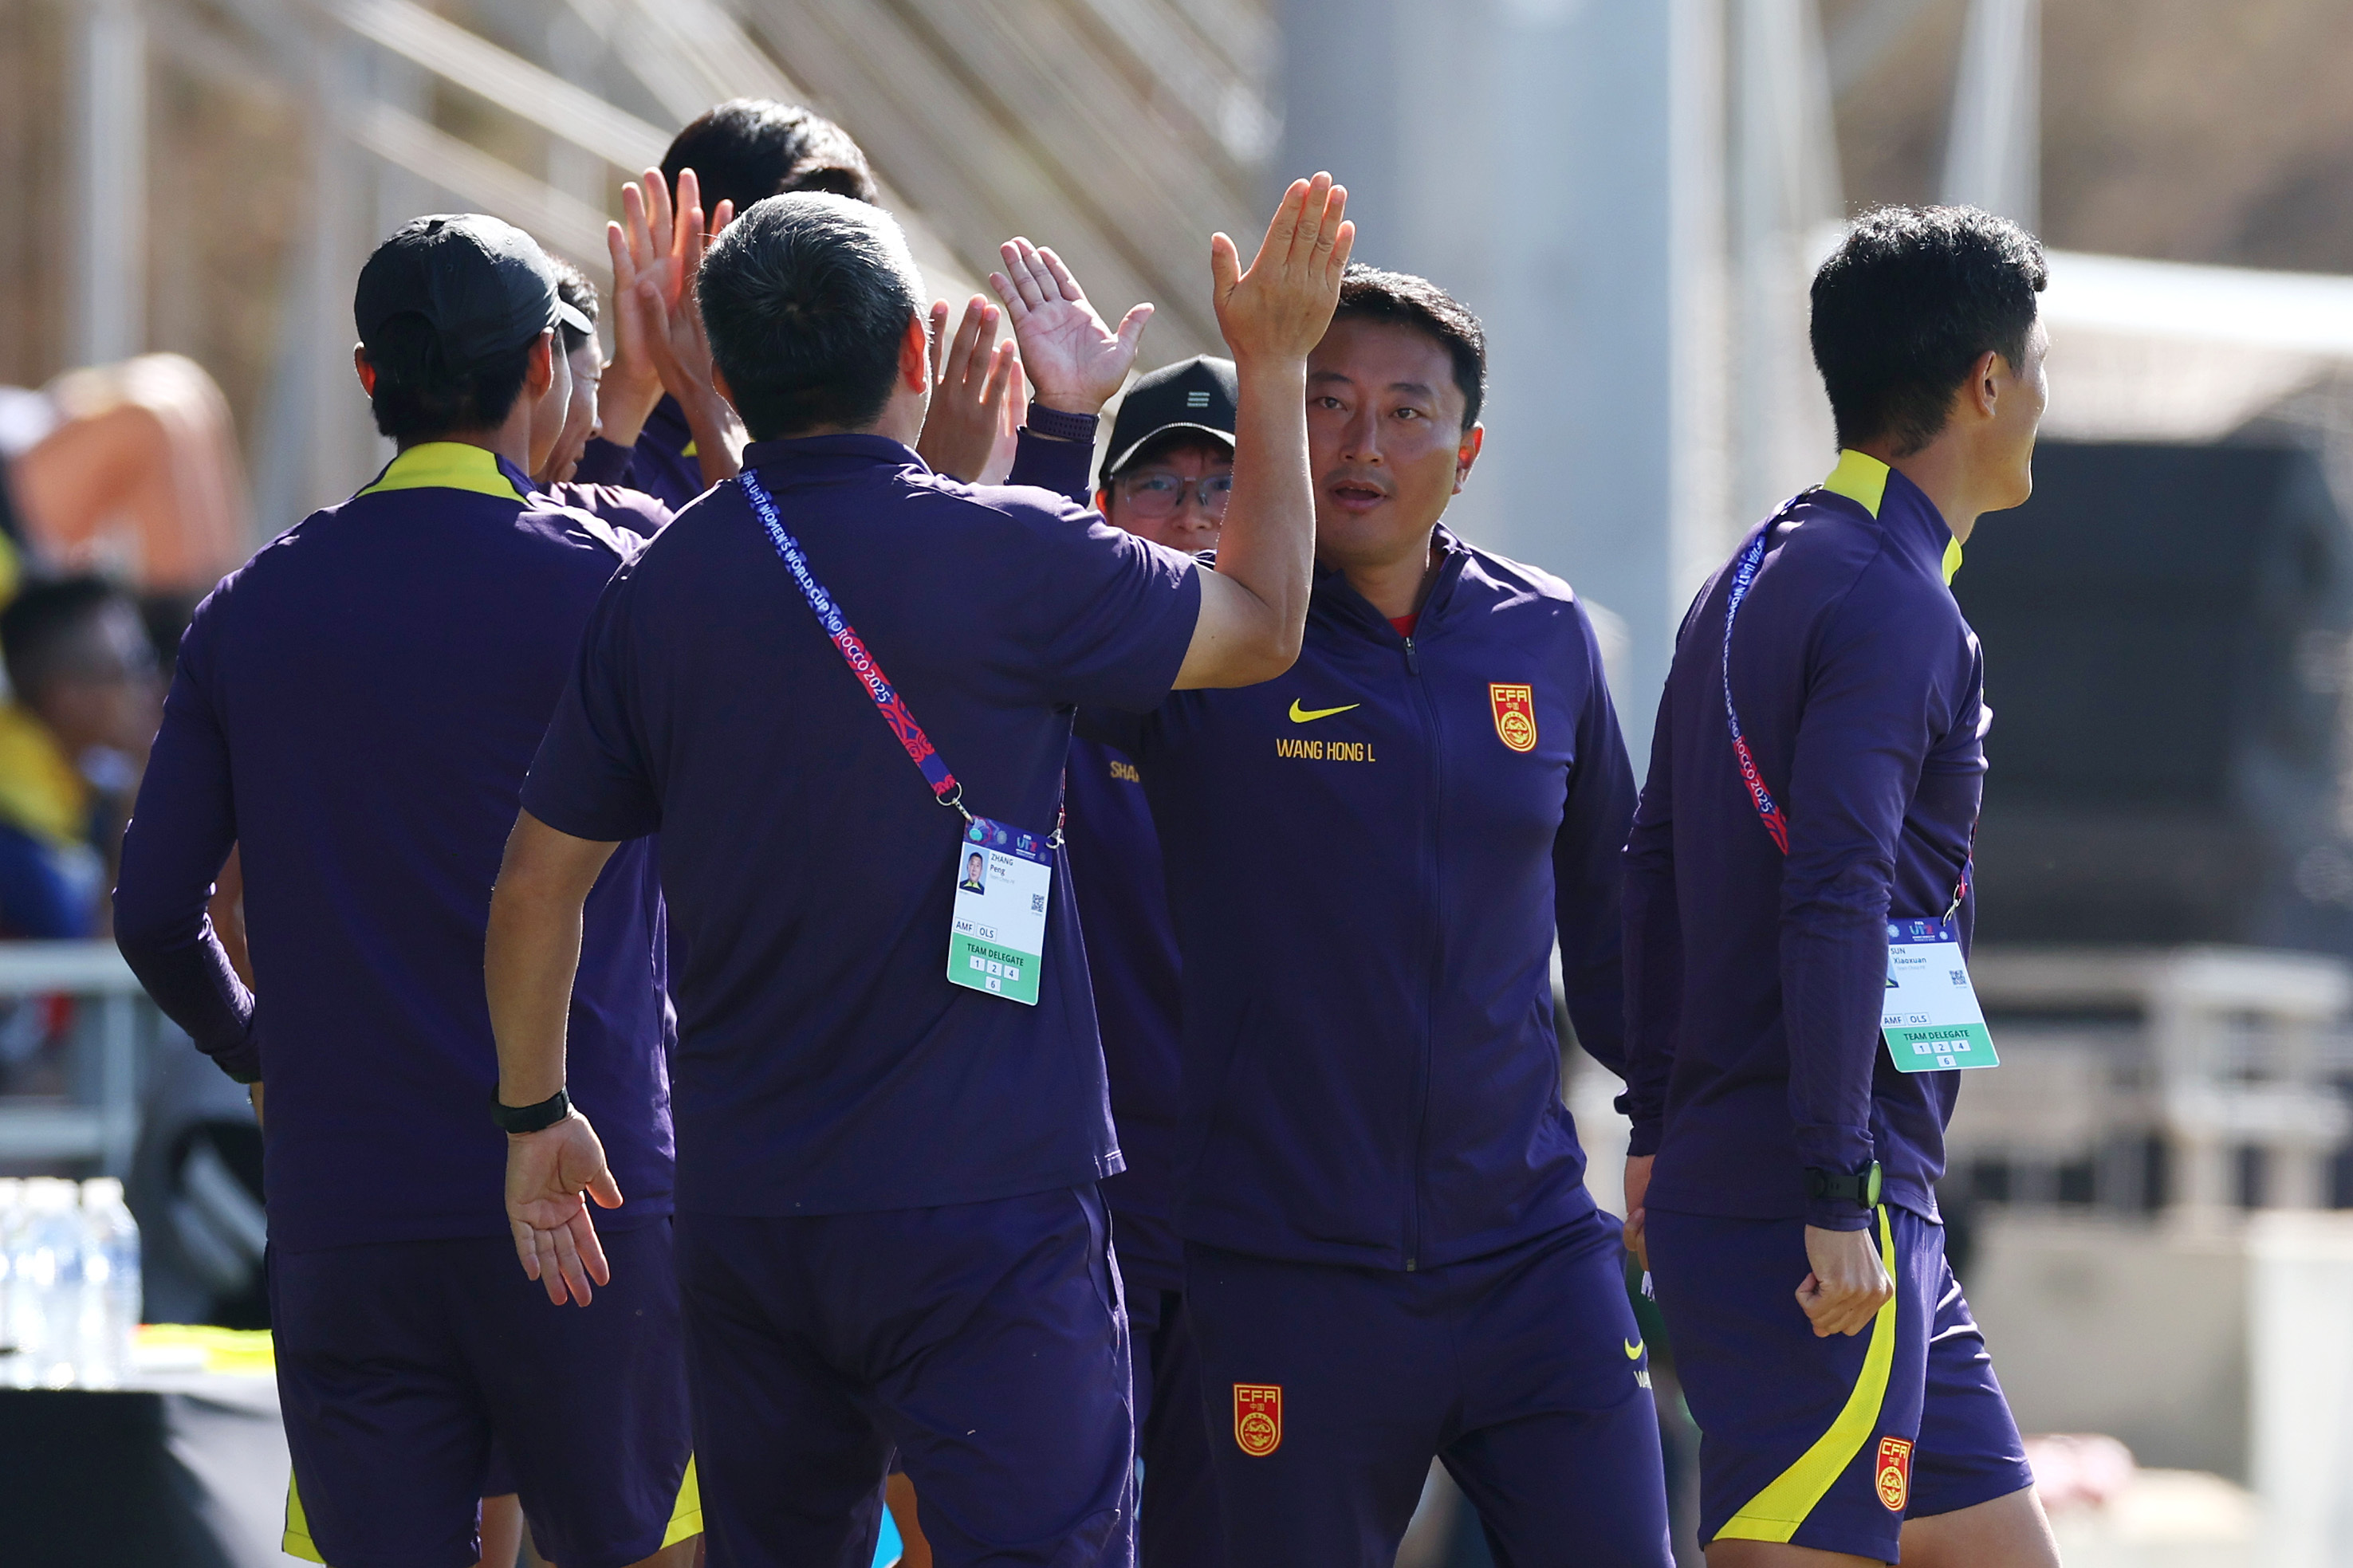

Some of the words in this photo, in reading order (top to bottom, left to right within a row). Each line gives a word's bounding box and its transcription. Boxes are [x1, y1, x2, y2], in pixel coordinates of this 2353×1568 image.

[1738, 563, 1756, 585] U-17
[741, 471, 755, 487] FIFA
[750, 485, 766, 504] U-17
[760, 504, 792, 552] WOMEN'S
[785, 548, 813, 589] WORLD
[810, 588, 829, 611] CUP
[824, 610, 869, 670] MOROCCO
[864, 670, 891, 702] 2025
[1495, 690, 1528, 702] CFA
[1276, 738, 1324, 760] WANG
[1327, 741, 1364, 762] HONG
[1367, 743, 1376, 762] L
[1751, 779, 1773, 812] 2025
[991, 853, 1013, 866] ZHANG
[990, 864, 1005, 877] Peng
[956, 921, 973, 932] AMF
[979, 927, 994, 938] OLS
[967, 943, 986, 956] TEAM
[988, 949, 1024, 967] DELEGATE
[992, 965, 997, 973] 2
[1884, 1016, 1902, 1024] AMF
[1928, 1029, 1970, 1039] DELEGATE
[1239, 1389, 1276, 1403] CFA
[1882, 1441, 1907, 1459] CFA
